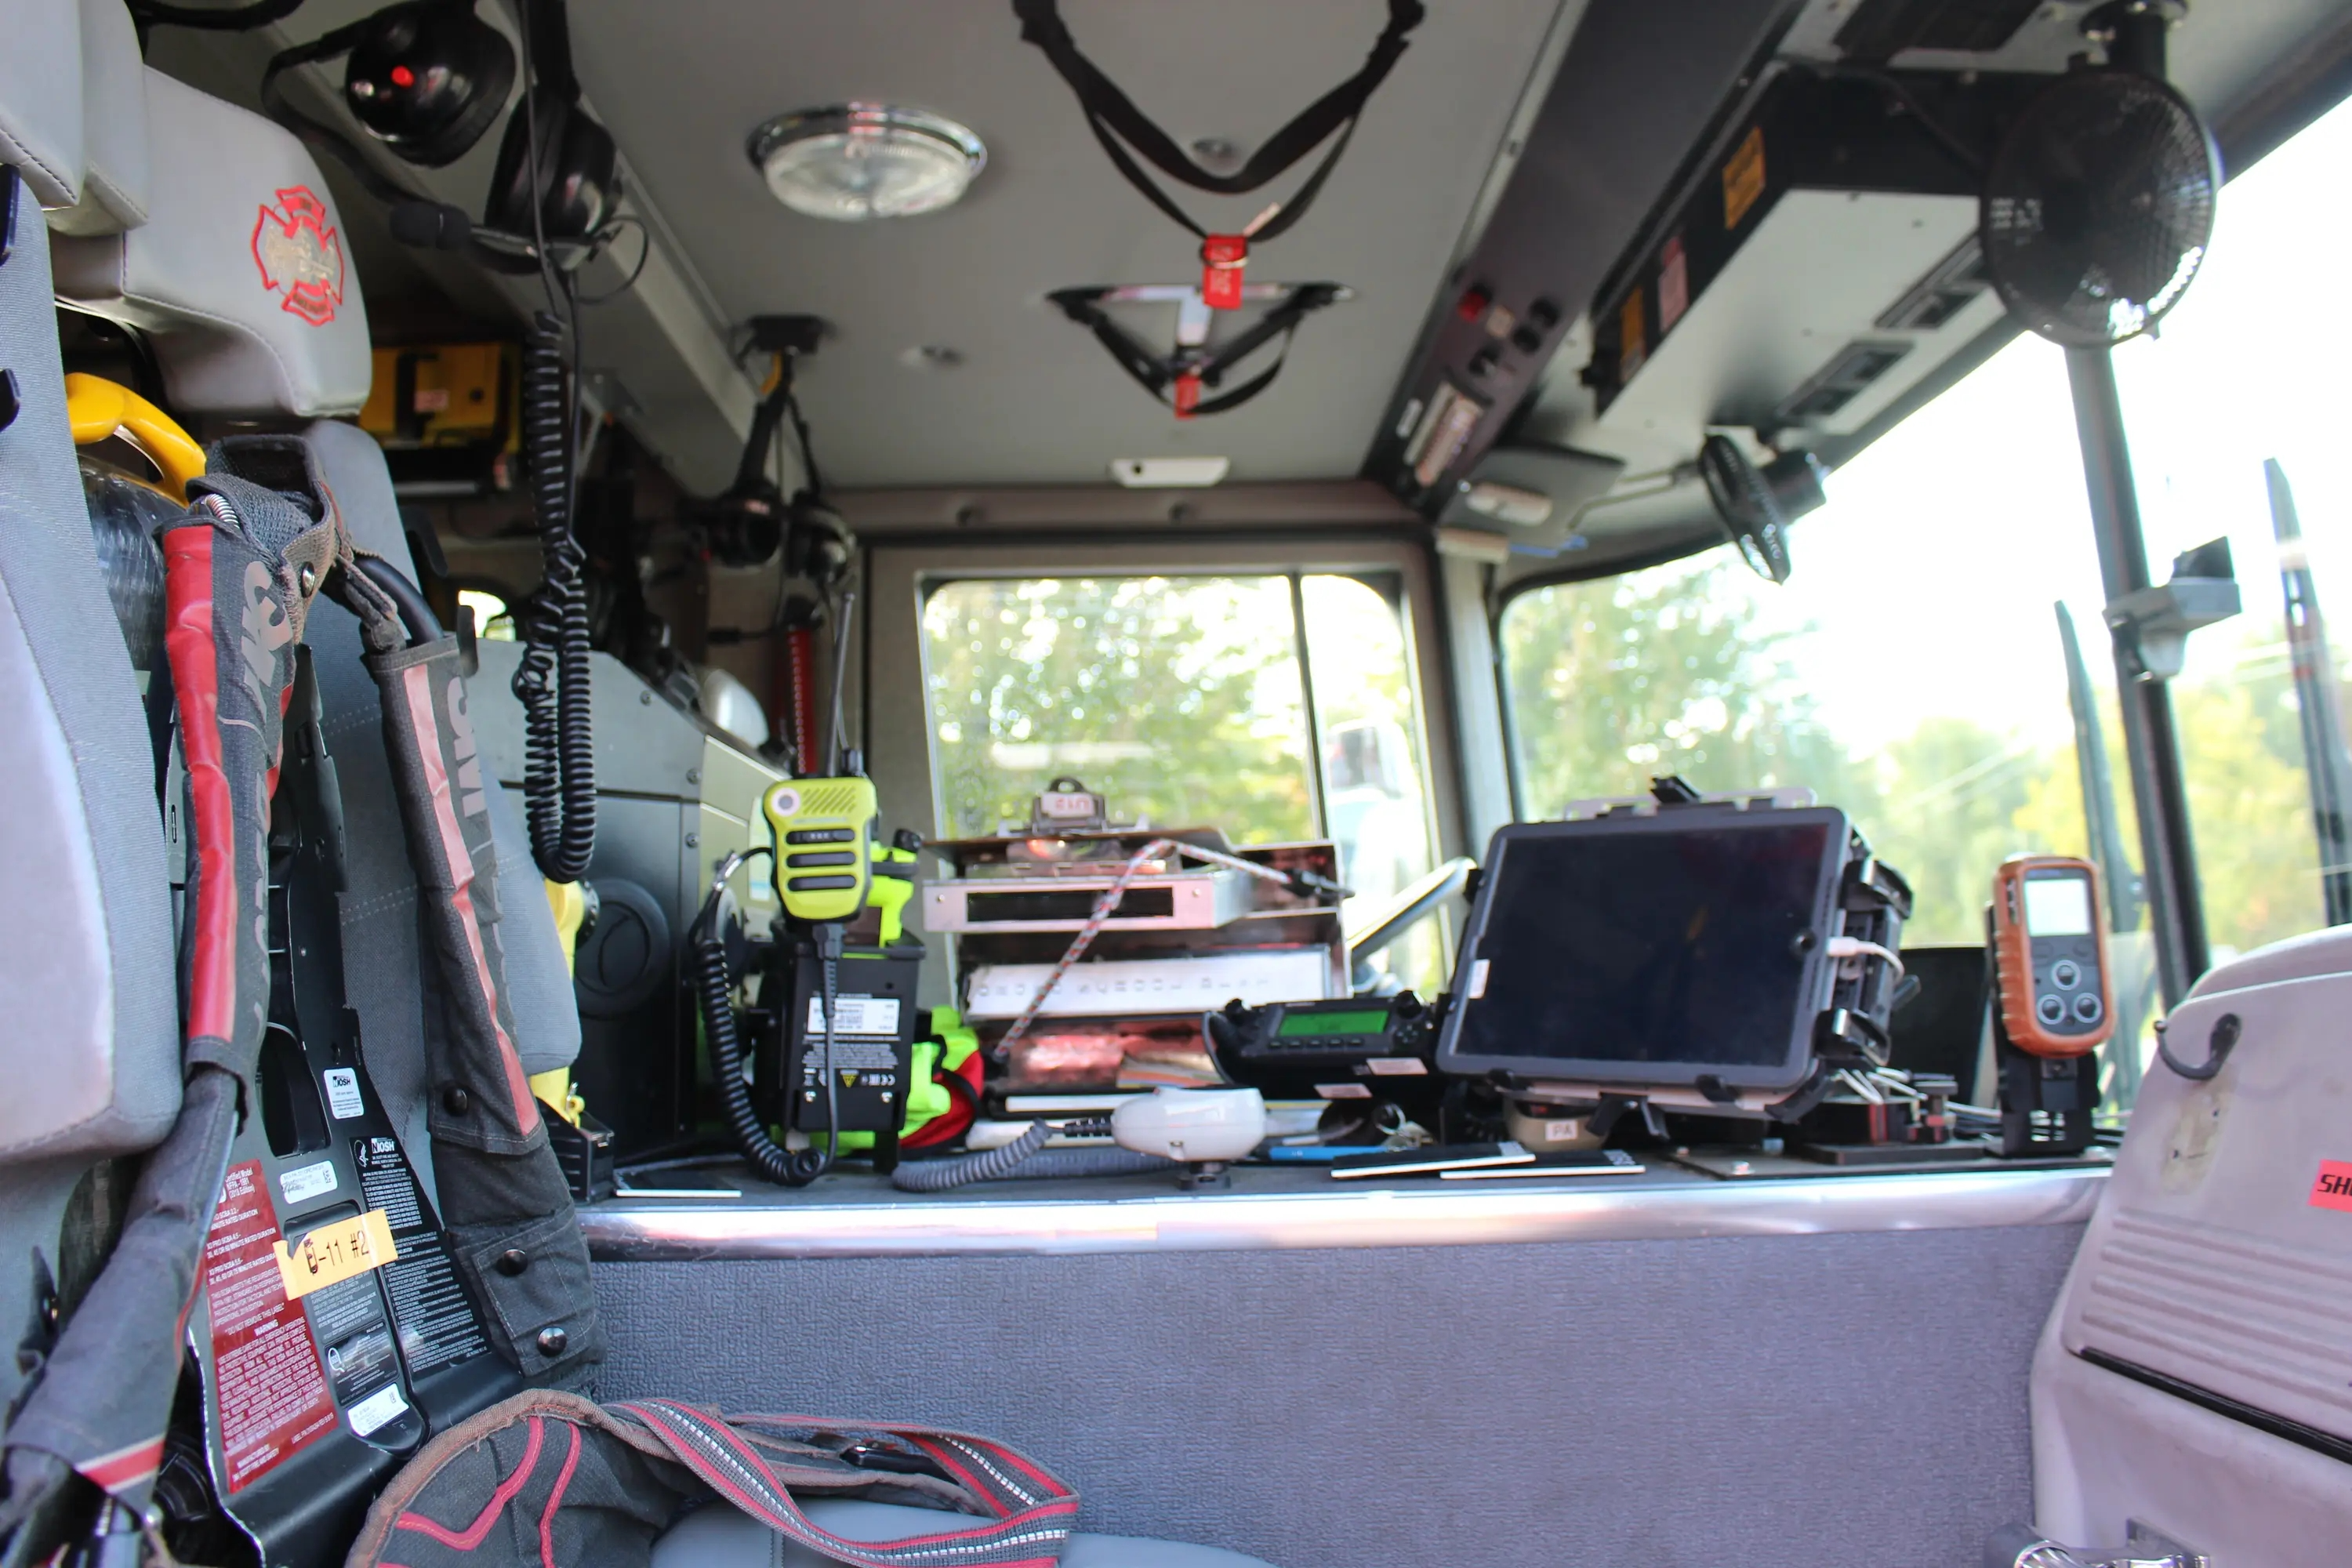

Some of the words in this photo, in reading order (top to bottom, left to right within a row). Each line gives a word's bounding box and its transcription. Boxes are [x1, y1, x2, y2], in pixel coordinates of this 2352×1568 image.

[241, 561, 293, 723] 3M
[333, 1078, 351, 1088] NIOSH
[372, 1141, 395, 1154] NIOSH
[240, 1167, 252, 1178] Model
[350, 1229, 370, 1258] #2
[253, 1317, 279, 1338] WARNING
